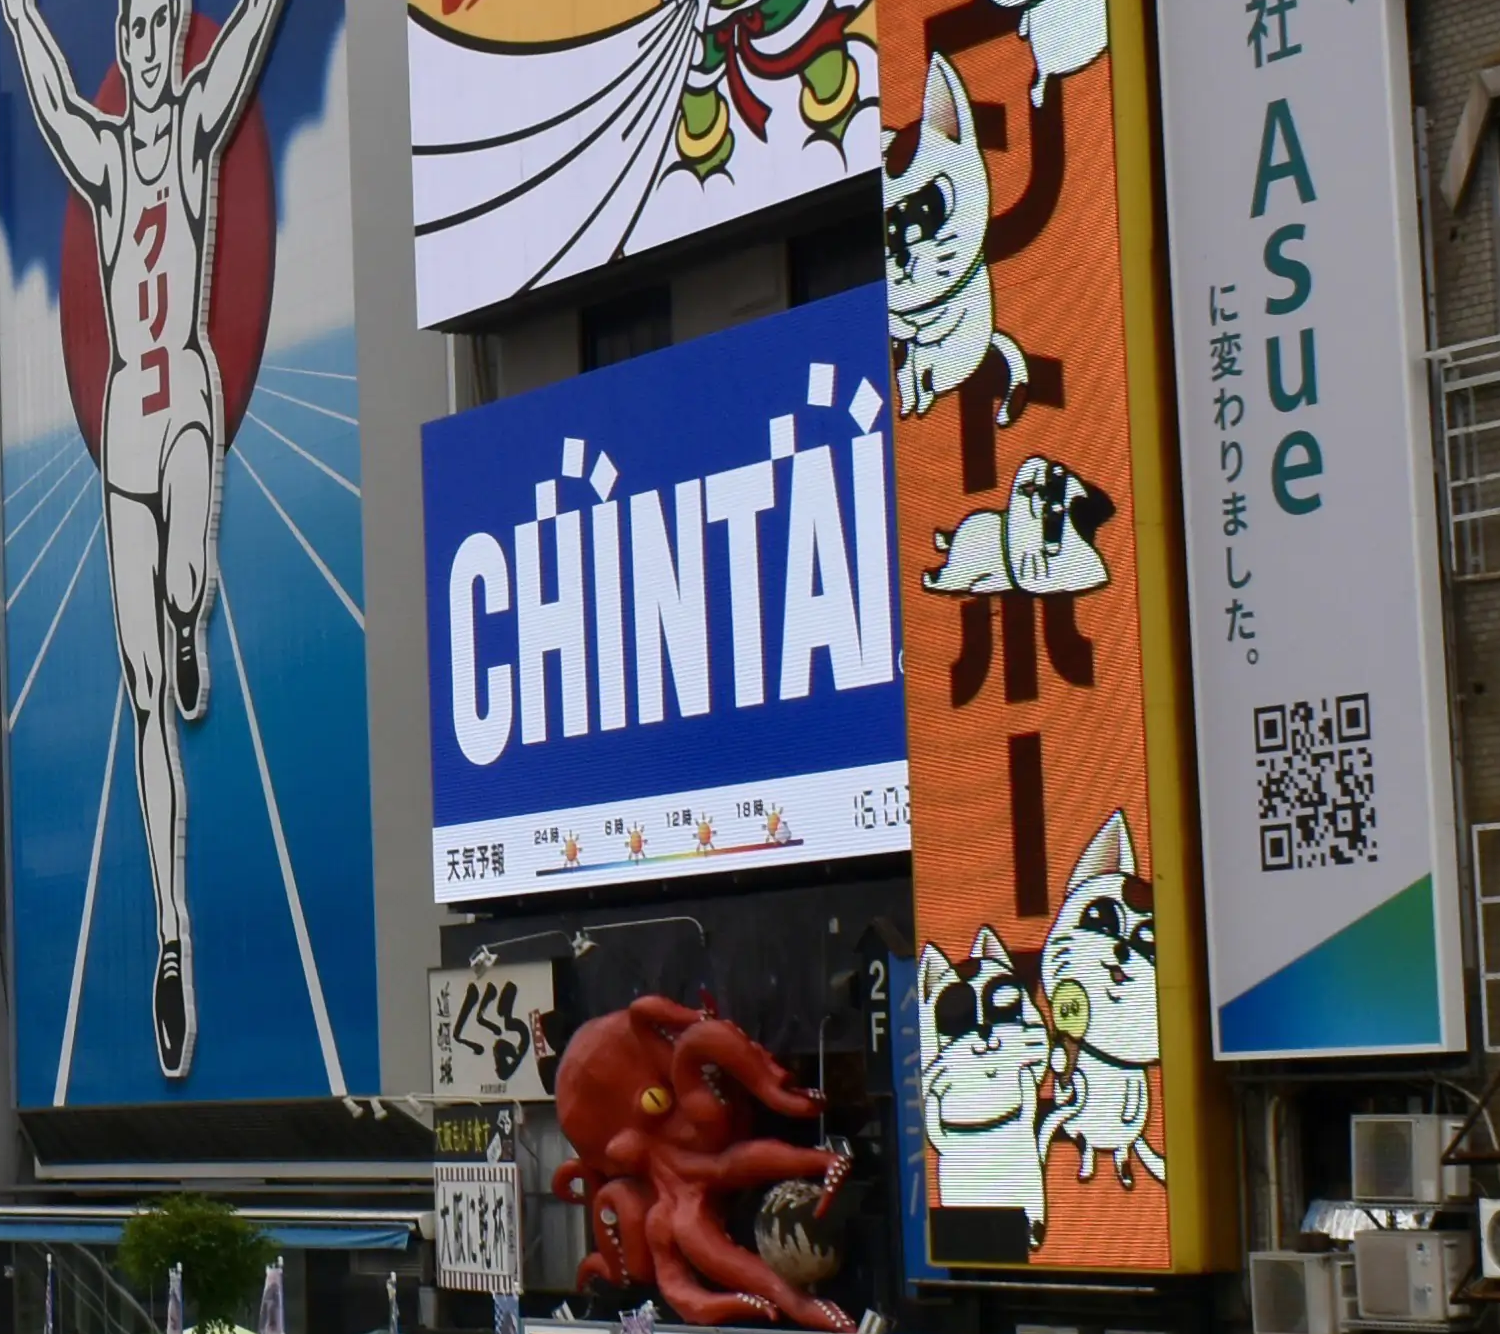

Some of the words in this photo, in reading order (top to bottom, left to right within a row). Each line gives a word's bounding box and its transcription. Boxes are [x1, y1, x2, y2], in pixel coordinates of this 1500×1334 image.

[132, 186, 172, 419] グリコ
[1249, 97, 1325, 516] Asue
[1206, 283, 1259, 666] に変わりました。
[446, 844, 506, 882] 天気予報
[452, 980, 531, 1081] くくる
